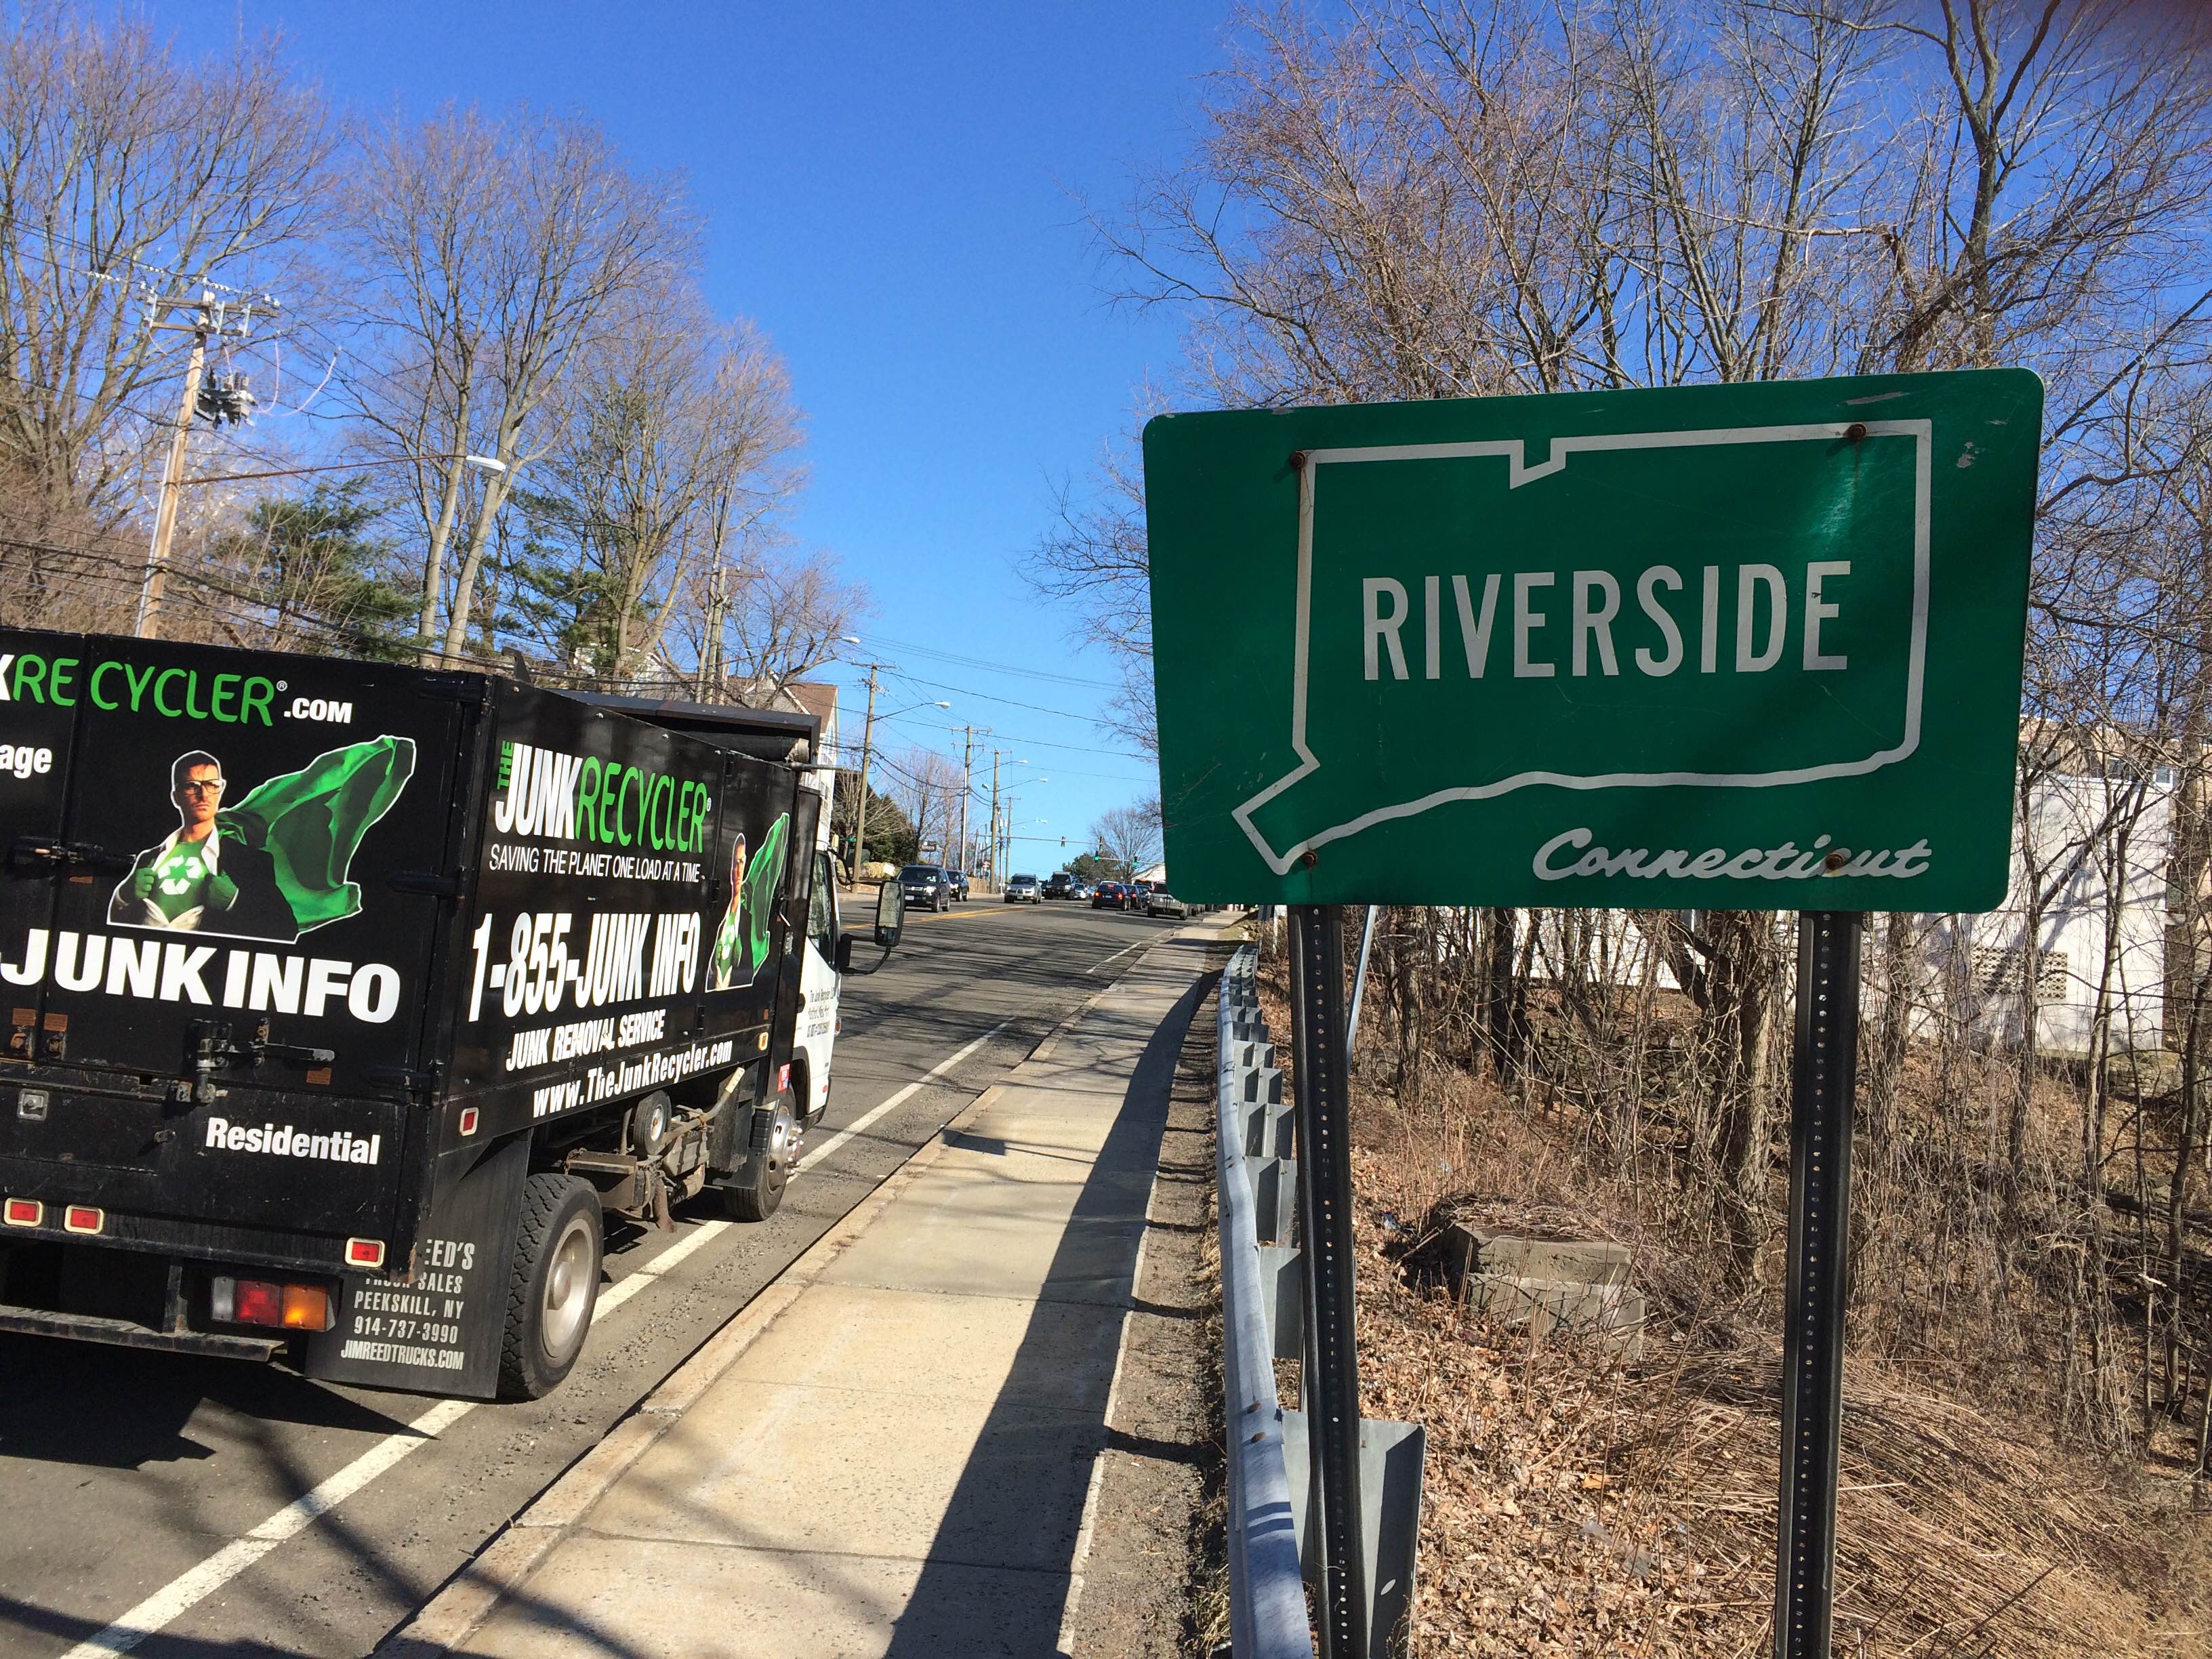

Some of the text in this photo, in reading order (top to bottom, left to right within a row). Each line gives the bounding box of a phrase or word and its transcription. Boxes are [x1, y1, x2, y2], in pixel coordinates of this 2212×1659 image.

[1363, 561, 1851, 680] RIVERSIDE
[283, 697, 352, 724] .COM
[497, 740, 514, 790] THE
[489, 844, 701, 883] SAVING THE PLANET ONE LOAD AT A TIME
[1533, 827, 1931, 880] Connecticut
[0, 928, 401, 1023] JUNK INFO
[468, 912, 700, 1022] 1-855-JUNK INFO
[506, 1009, 666, 1071] JUNK REMOVAL SERVICE
[533, 1040, 733, 1118] www.TheJunkRecycler.com
[205, 1117, 381, 1165] Residential
[354, 1290, 464, 1319] PEEKSKILL, NY
[417, 1271, 463, 1294] SALES
[354, 1315, 459, 1345] 914-737-3990
[340, 1339, 465, 1371] JIMREEDTRUCKS.COM
